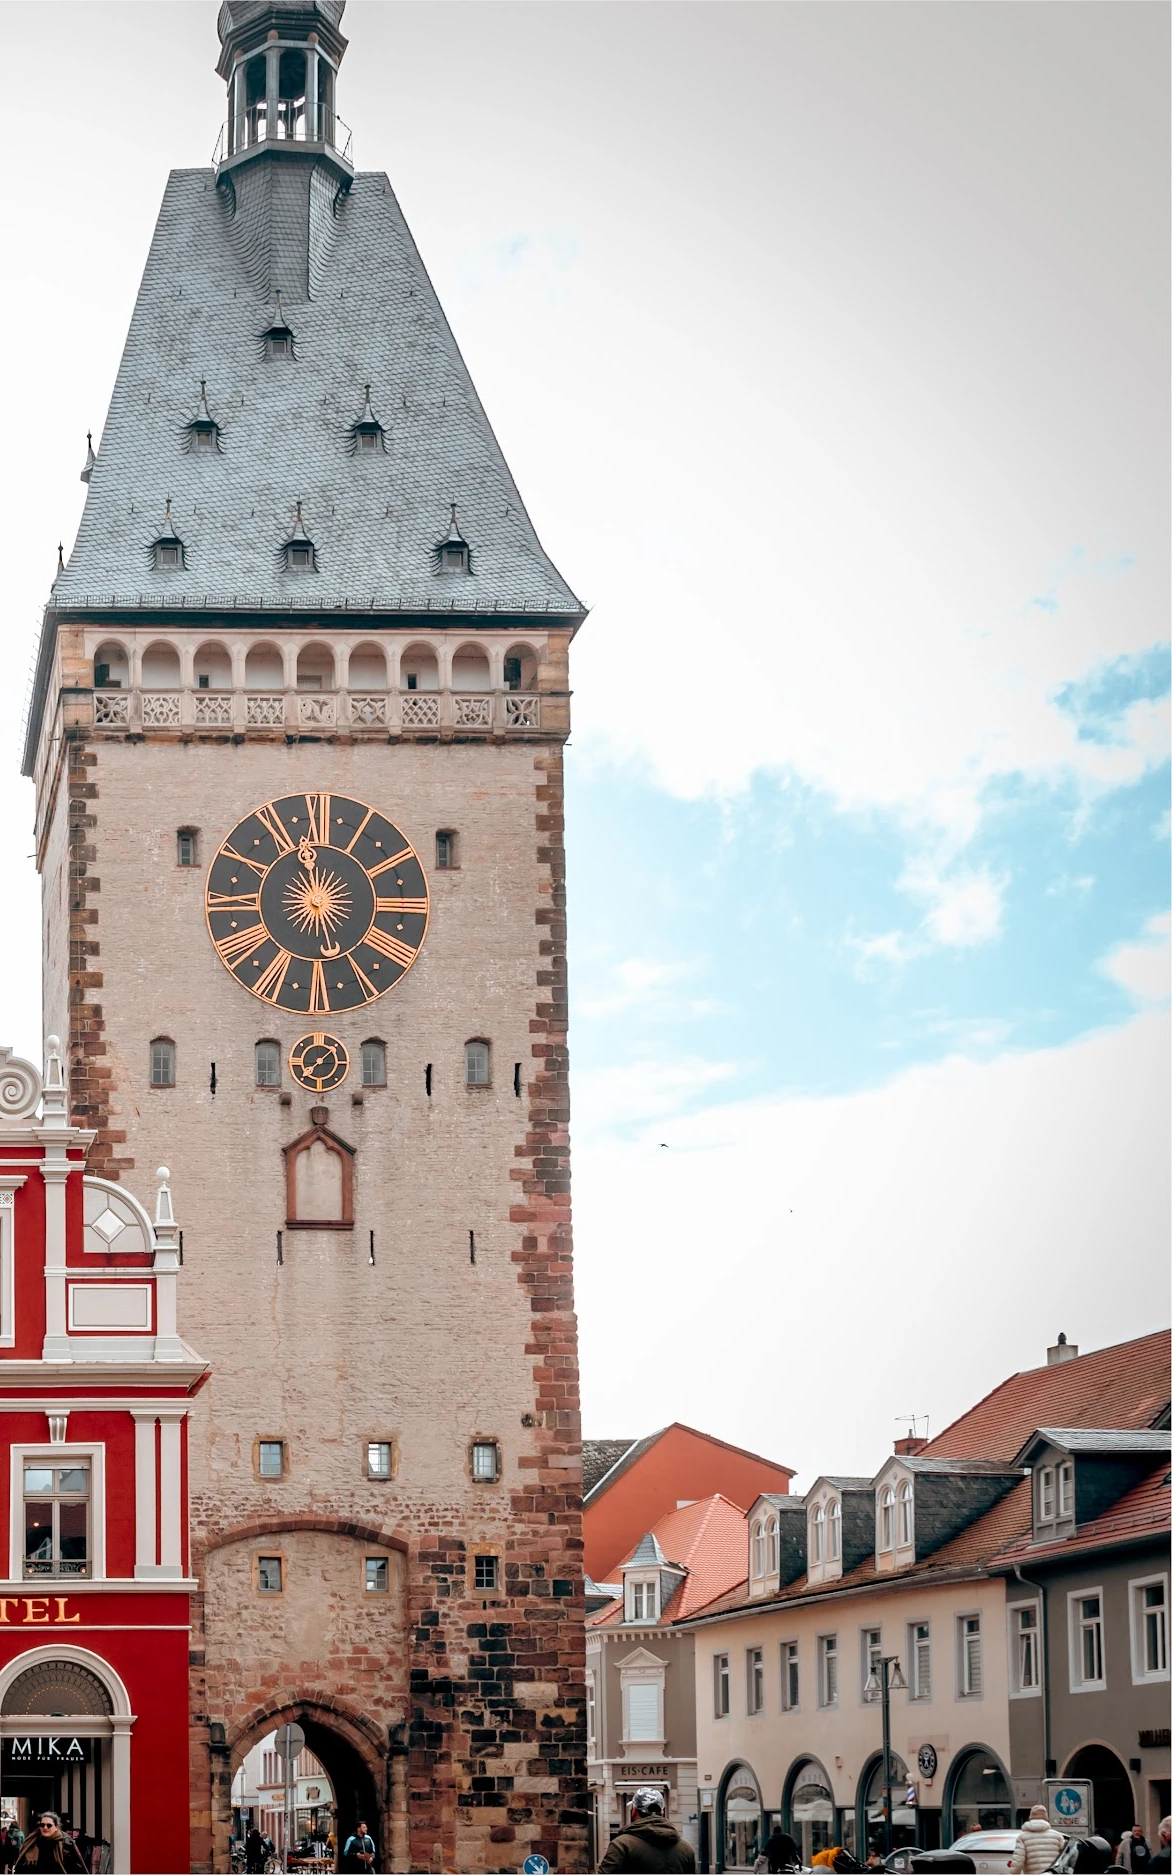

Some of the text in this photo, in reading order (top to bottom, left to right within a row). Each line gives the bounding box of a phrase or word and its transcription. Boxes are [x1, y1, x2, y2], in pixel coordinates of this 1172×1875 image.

[255, 803, 295, 855] XI
[305, 794, 332, 844] XII
[346, 808, 376, 854] I
[219, 842, 269, 878] X
[366, 846, 416, 879] II
[207, 890, 260, 913] IX
[376, 897, 428, 914] III
[216, 922, 270, 970] VIII
[251, 951, 291, 1003] VII
[309, 960, 330, 1012] VI
[346, 953, 380, 1001] V
[12, 1737, 84, 1755] MIKA
